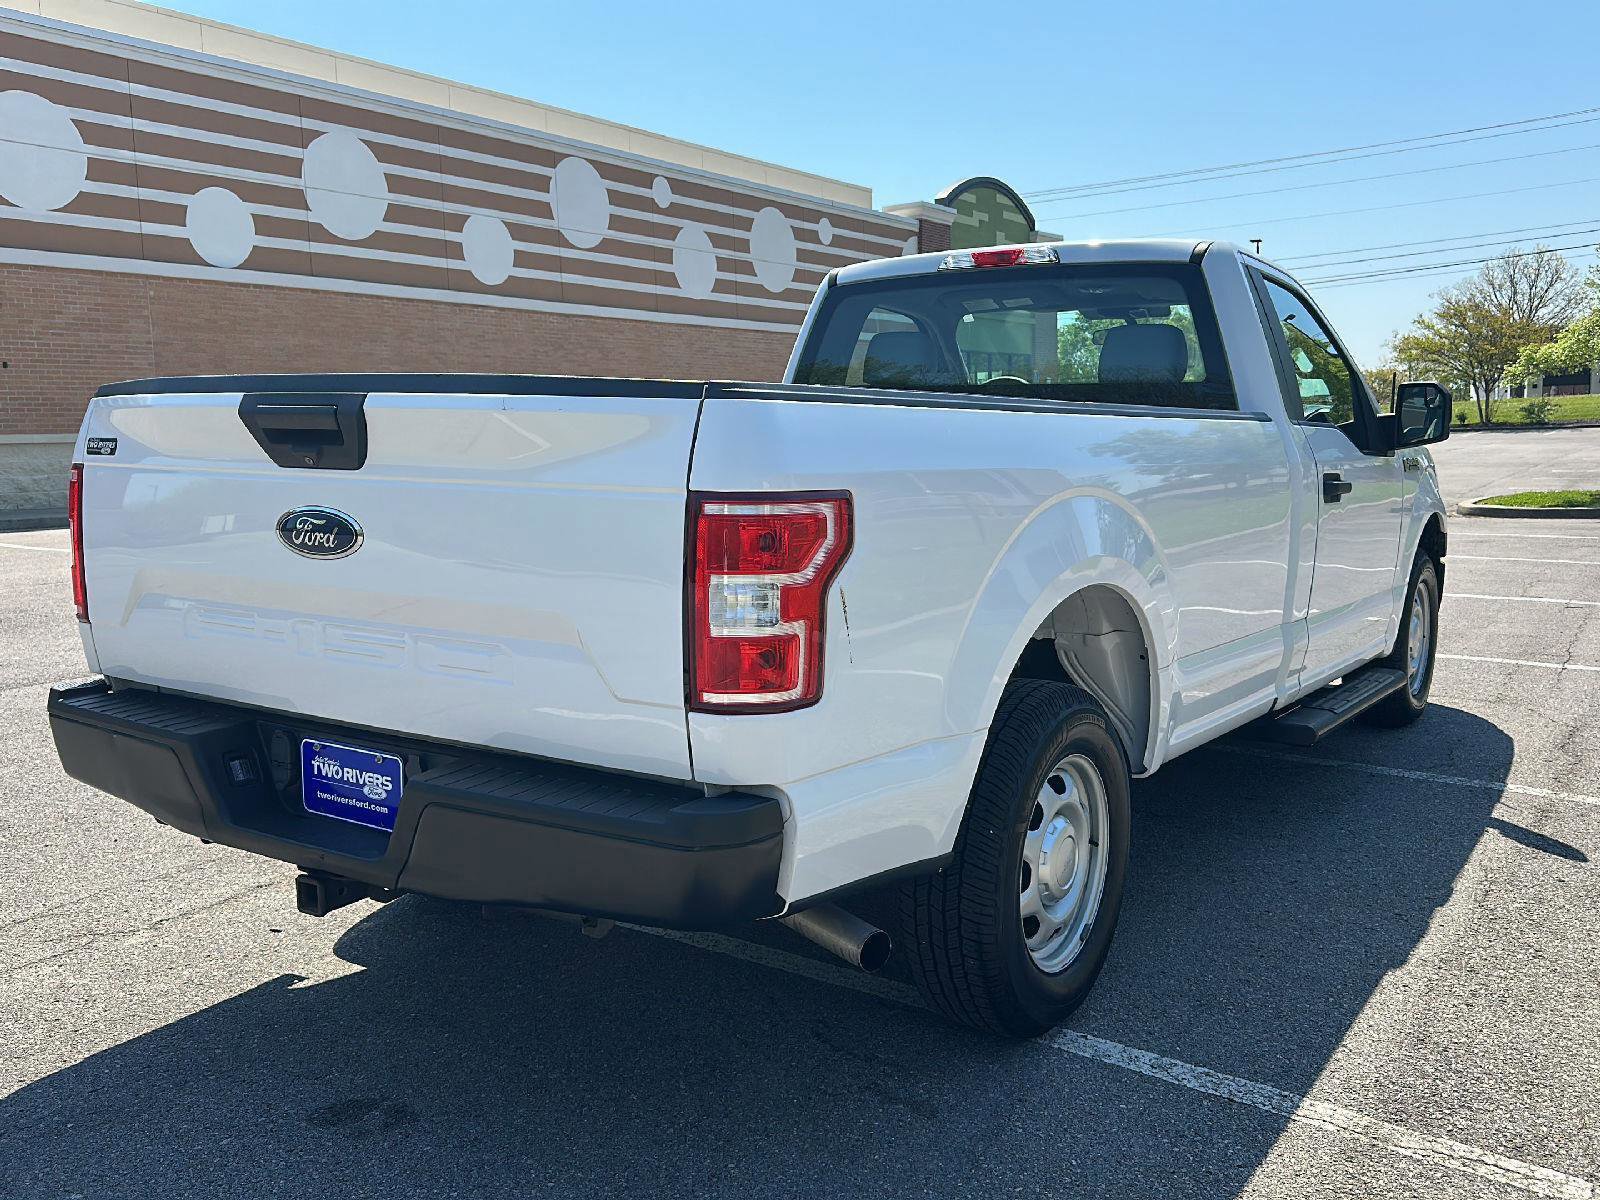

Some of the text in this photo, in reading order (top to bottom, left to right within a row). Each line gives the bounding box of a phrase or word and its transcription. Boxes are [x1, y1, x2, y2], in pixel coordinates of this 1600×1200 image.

[292, 516, 339, 548] Ford
[311, 760, 342, 780] TWO
[343, 767, 393, 791] RIVERS
[317, 790, 388, 813] tworiversford.com
